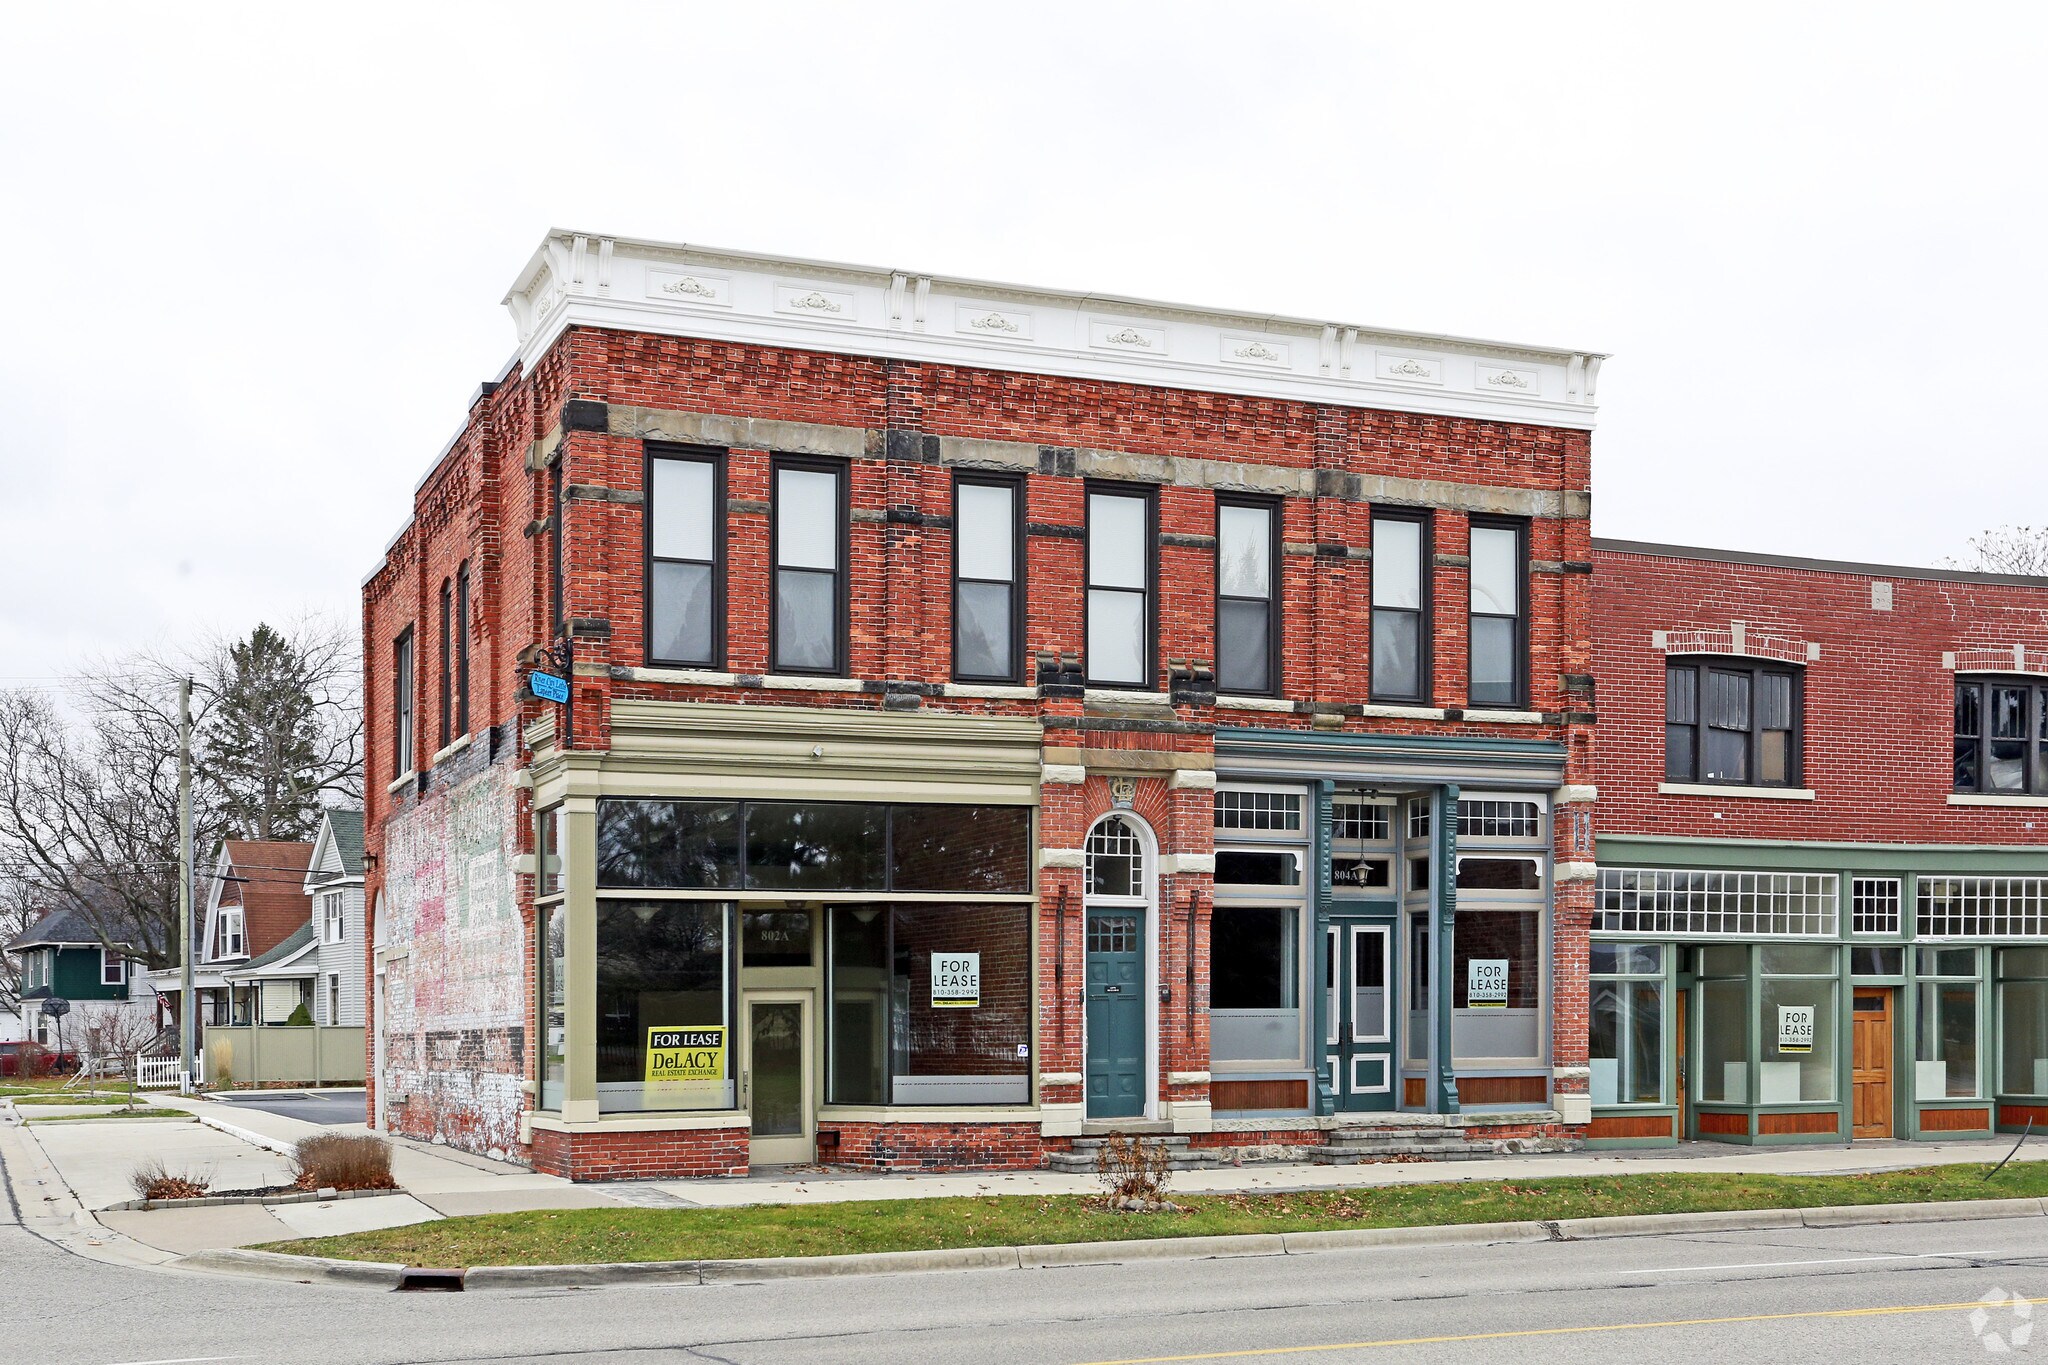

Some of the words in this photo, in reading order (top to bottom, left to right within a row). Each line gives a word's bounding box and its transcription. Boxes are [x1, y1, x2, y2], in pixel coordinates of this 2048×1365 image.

[1334, 870, 1358, 881] 804A
[761, 930, 789, 941] 802A
[941, 960, 970, 972] FOR
[1477, 966, 1501, 977] FOR
[934, 975, 977, 987] LEASE
[1470, 979, 1506, 990] LEASE
[1785, 1012, 1808, 1023] FOR
[1780, 1025, 1812, 1036] LEASE
[653, 1034, 680, 1047] FOR
[683, 1033, 720, 1046] LEASE
[652, 1051, 718, 1070] DeLACY
[651, 1069, 666, 1077] REAL
[688, 1068, 718, 1076] EXCHANGE
